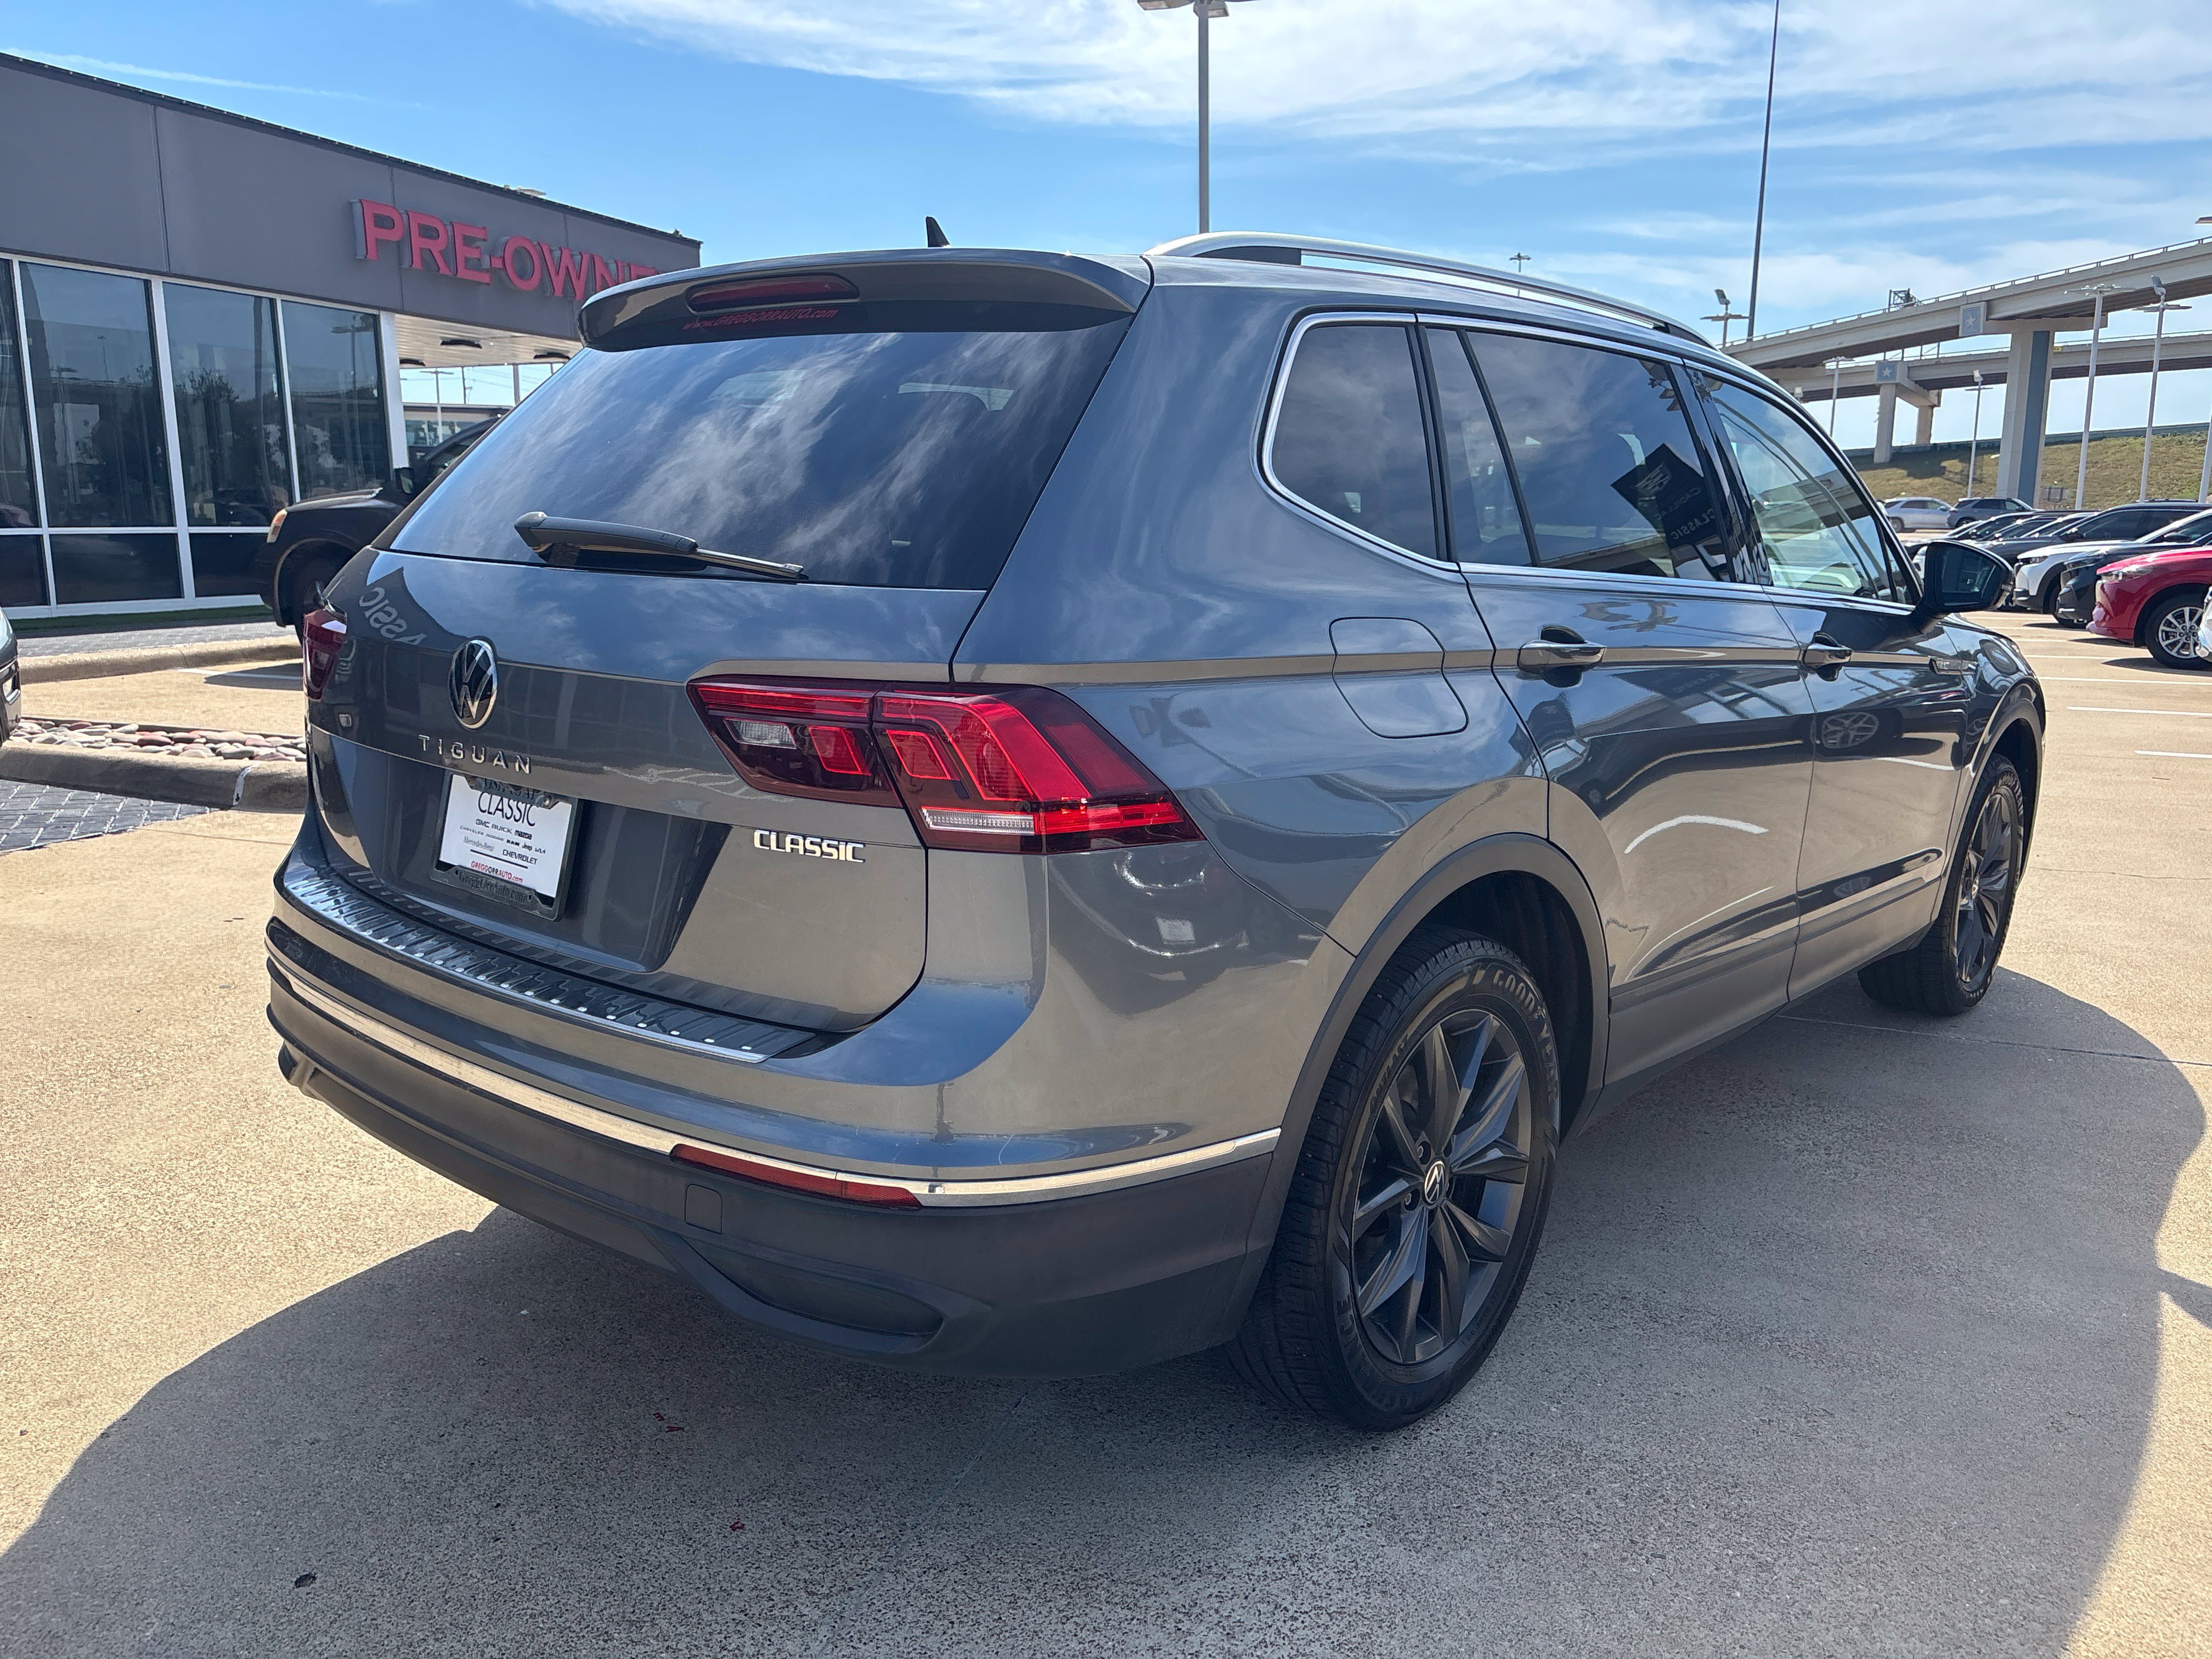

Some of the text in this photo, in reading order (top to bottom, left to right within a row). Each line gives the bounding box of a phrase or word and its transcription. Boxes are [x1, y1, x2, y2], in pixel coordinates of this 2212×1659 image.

[359, 199, 666, 300] PRE-OWN
[417, 733, 532, 775] TIGUAN
[476, 818, 490, 828] GMC
[492, 823, 512, 834] BUICK
[478, 792, 538, 827] CLASSIC
[503, 849, 538, 865] CHEVROLET
[522, 843, 533, 851] Jeep
[754, 829, 866, 863] CLASSIC
